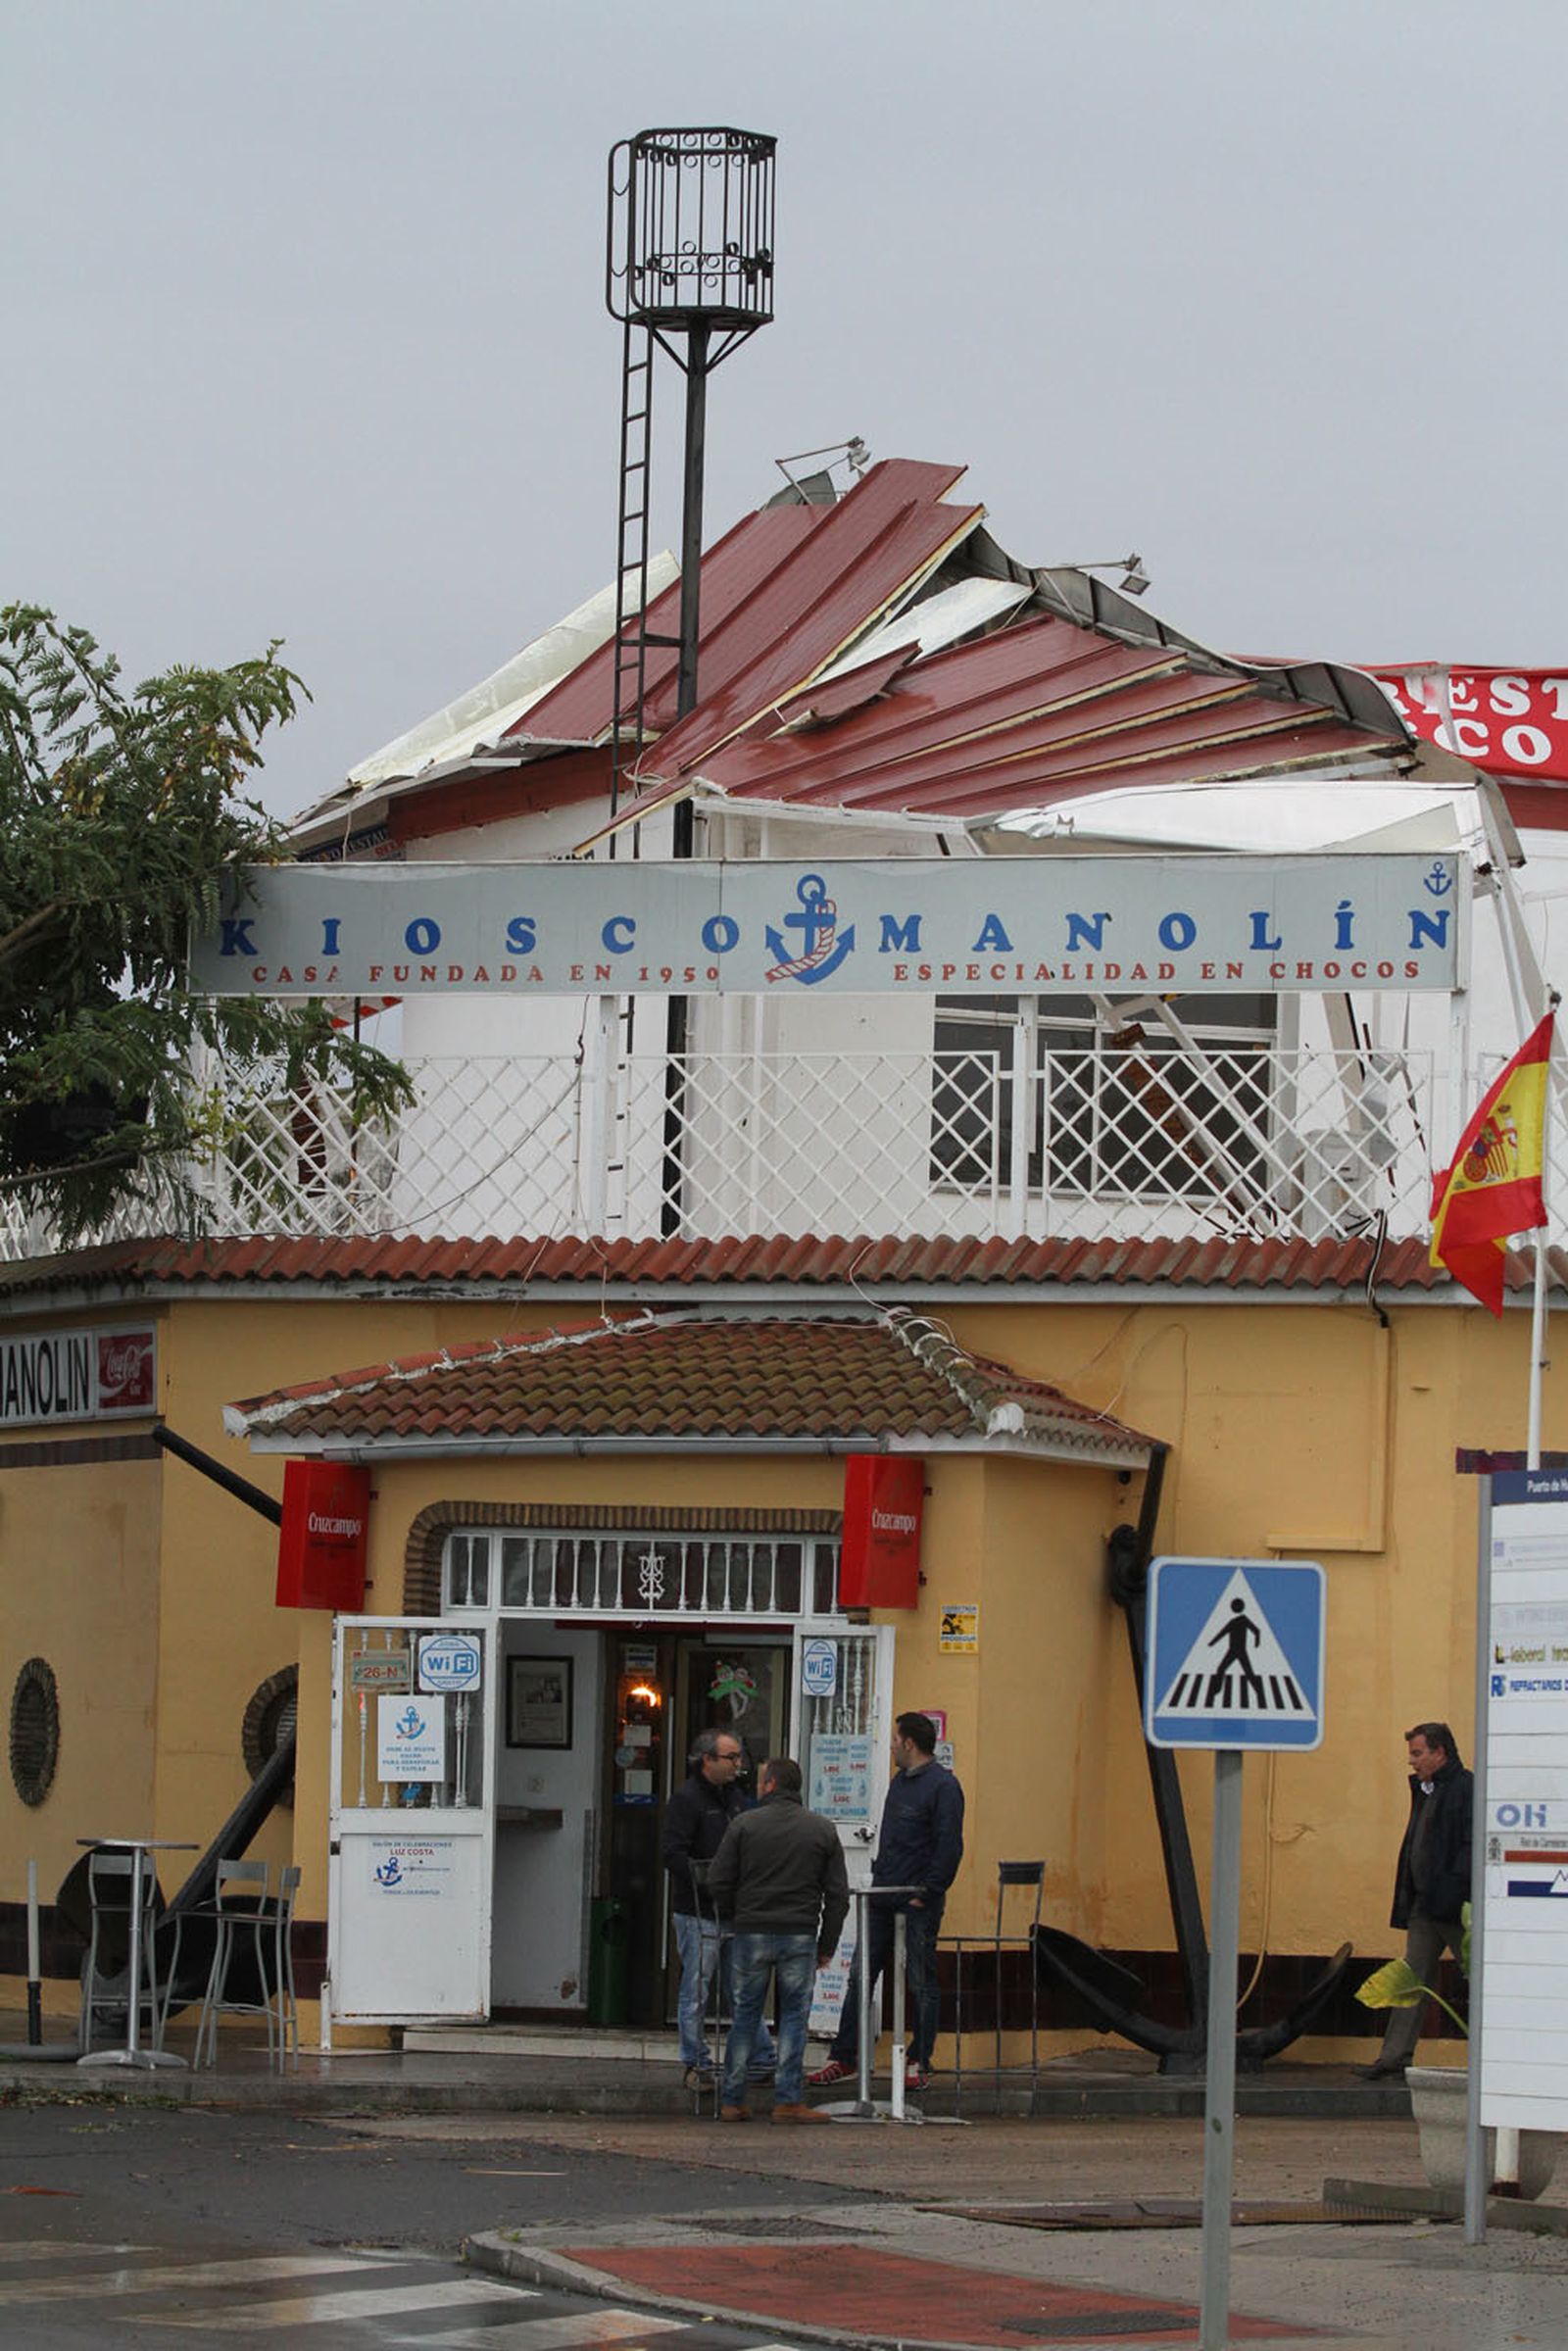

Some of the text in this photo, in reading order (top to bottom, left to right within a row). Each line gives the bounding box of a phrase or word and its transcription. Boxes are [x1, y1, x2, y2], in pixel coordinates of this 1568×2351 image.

[220, 900, 1449, 956] KIOSCO MANOLÍN
[369, 965, 545, 983] FUNDADA
[570, 964, 612, 982] EN
[639, 966, 720, 983] 1950
[894, 962, 1177, 981] ESPECIALIDAD
[1201, 962, 1245, 980] EN
[1270, 960, 1420, 980] CHOCOS
[0, 1337, 89, 1418] ANOLIN
[309, 1511, 362, 1539] Cruzcampo
[871, 1508, 916, 1536] Cruzcampo
[364, 1667, 398, 1679] 26-N
